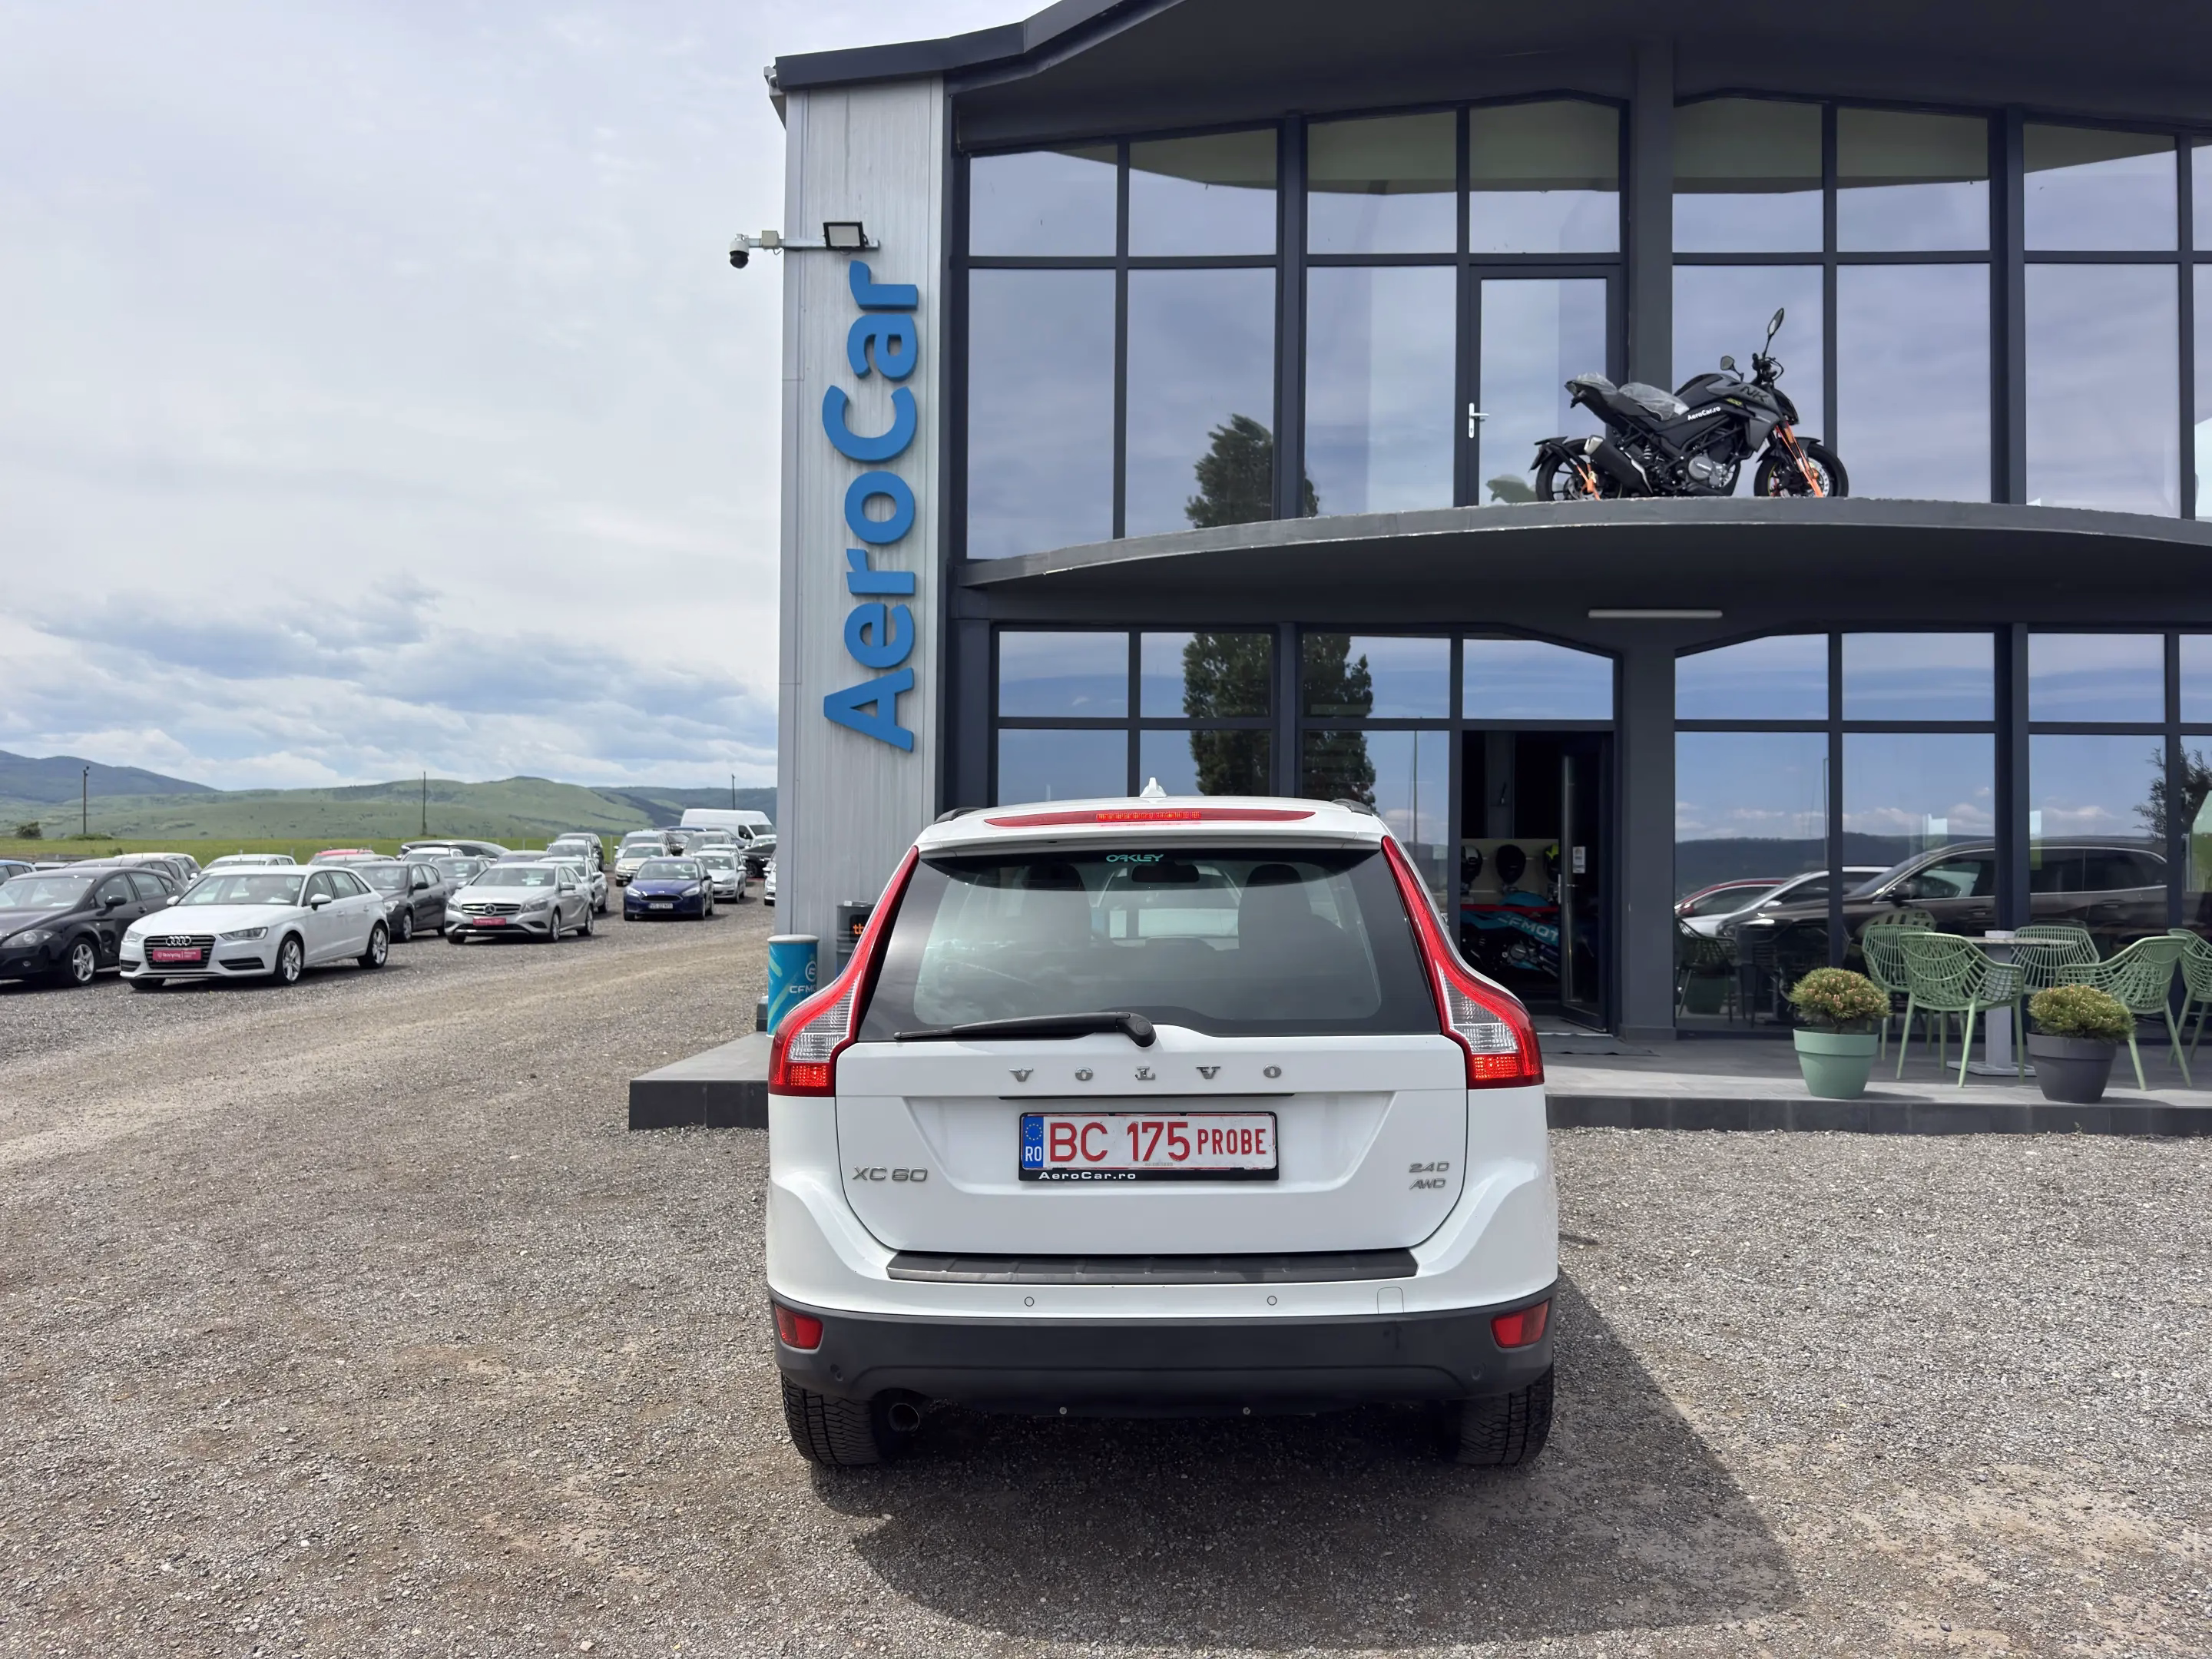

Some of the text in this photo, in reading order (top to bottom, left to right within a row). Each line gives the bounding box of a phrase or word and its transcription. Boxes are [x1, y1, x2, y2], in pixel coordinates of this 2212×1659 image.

[1687, 406, 1721, 422] AeroCar.ro
[822, 260, 919, 753] AeroCar
[1106, 853, 1164, 863] OAKLEY
[1008, 1064, 1282, 1082] VOLVO
[1049, 1121, 1267, 1163] BC 175 PROBE
[1025, 1146, 1042, 1162] RO
[852, 1166, 928, 1182] XC 60
[1038, 1171, 1136, 1180] AeroCar.ro
[1409, 1177, 1446, 1190] AWD
